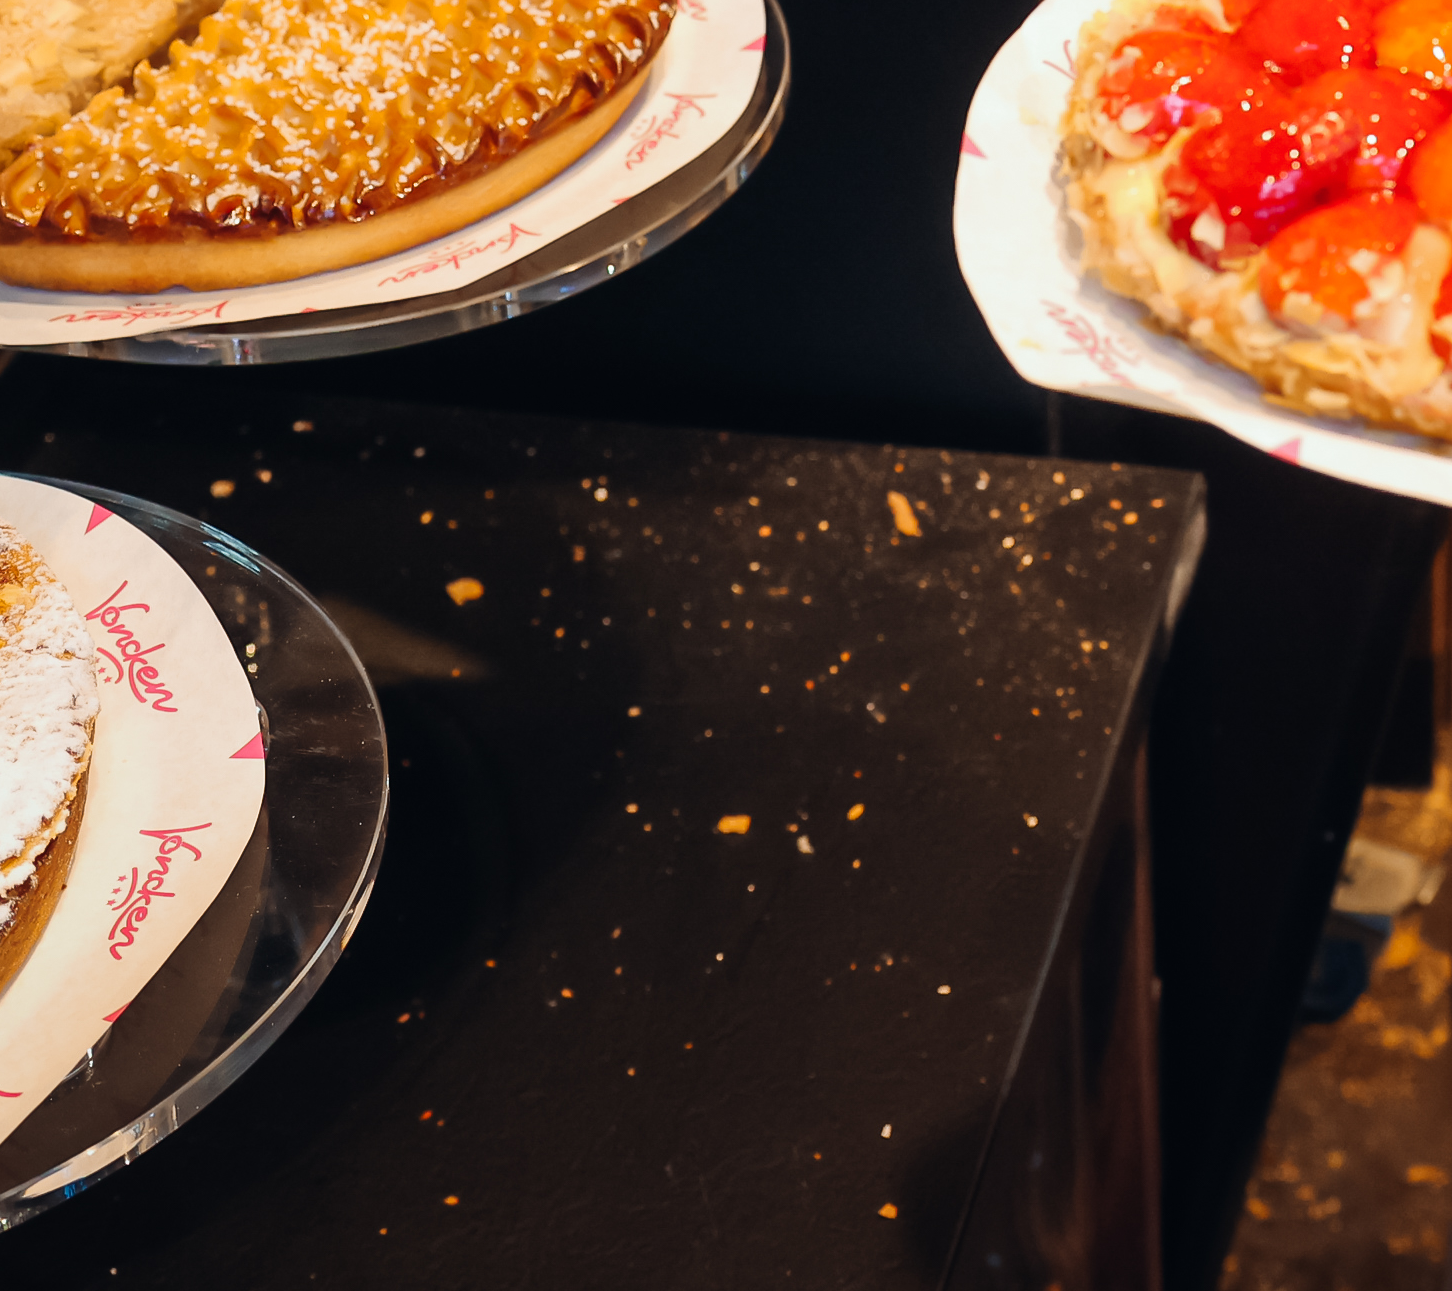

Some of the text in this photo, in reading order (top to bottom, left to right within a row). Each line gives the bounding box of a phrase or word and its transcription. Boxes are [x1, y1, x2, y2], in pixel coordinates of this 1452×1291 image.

[623, 90, 717, 172] Voncken
[376, 220, 542, 289] Voncken
[46, 298, 231, 326] Voncken
[84, 581, 178, 712] Voncken
[108, 822, 212, 960] Voncken
